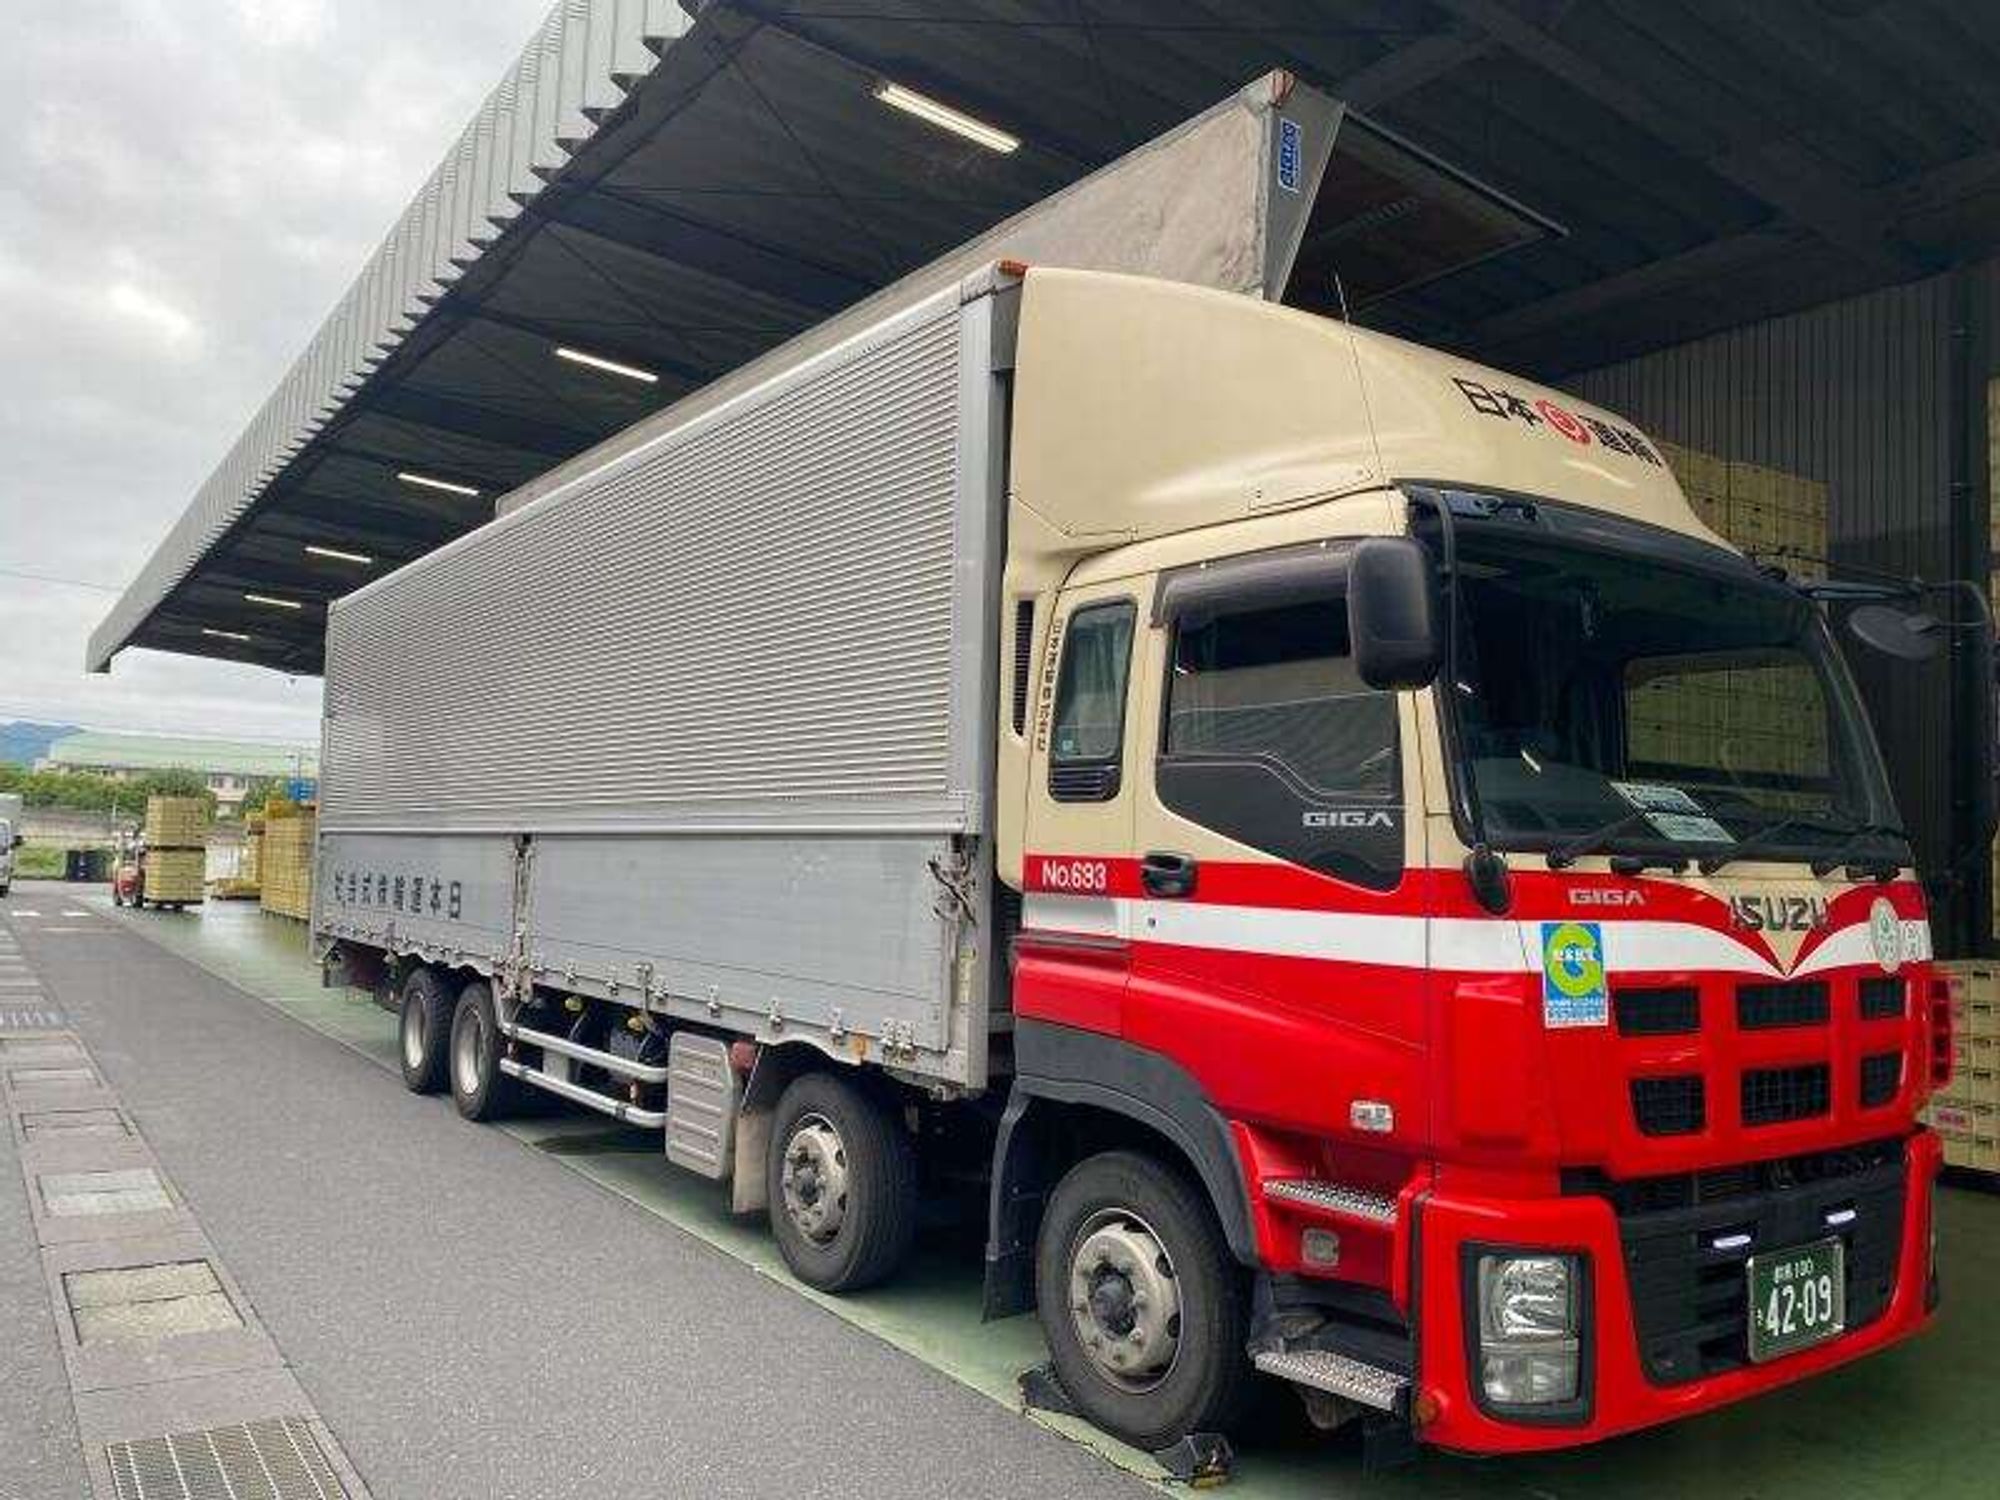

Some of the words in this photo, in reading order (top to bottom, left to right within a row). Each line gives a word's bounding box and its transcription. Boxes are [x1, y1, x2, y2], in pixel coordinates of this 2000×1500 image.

[1302, 811, 1394, 827] GIGA
[1568, 888, 1645, 906] GIGA
[1729, 895, 1831, 931] ISUZU
